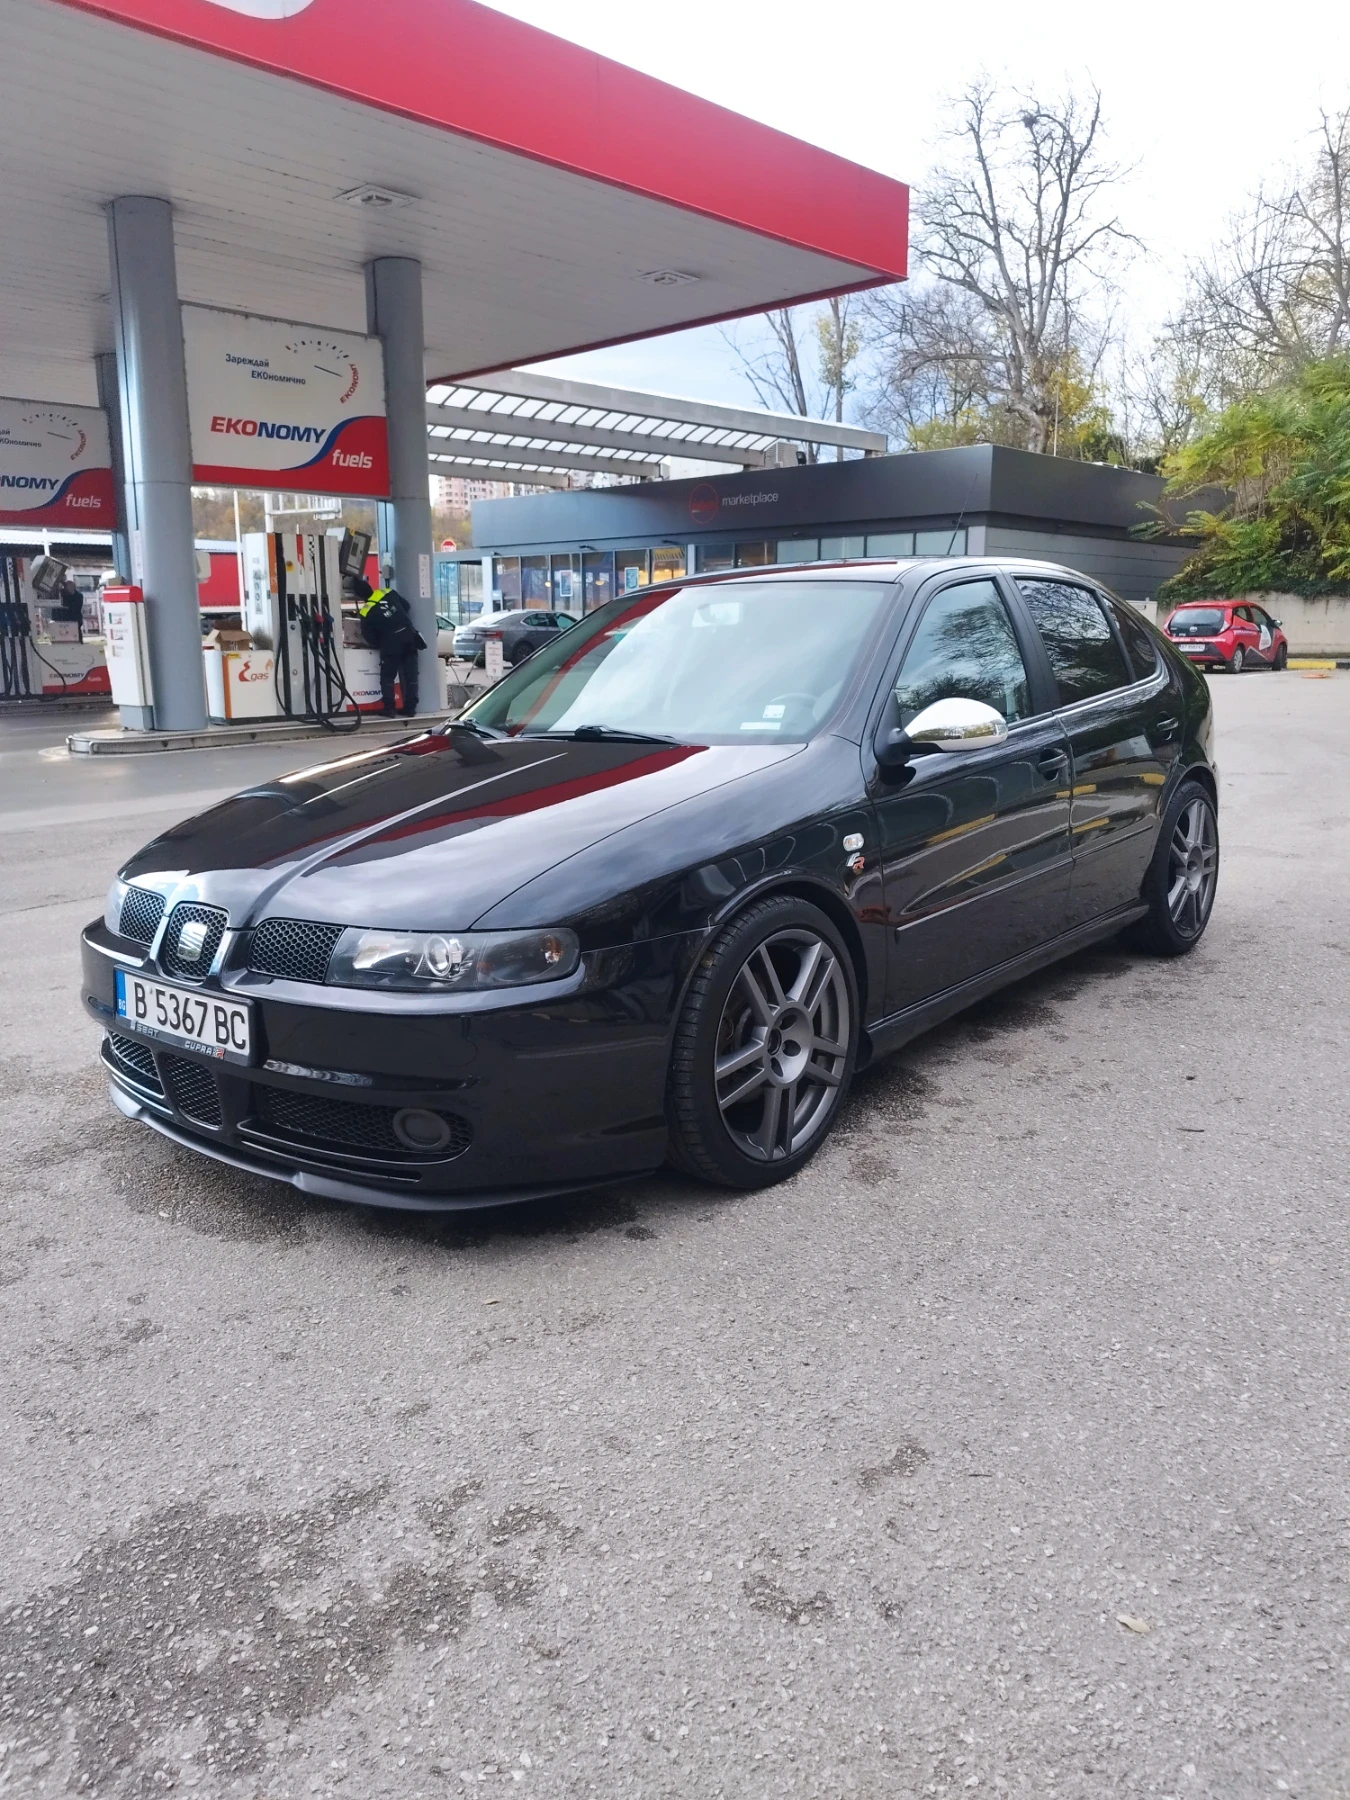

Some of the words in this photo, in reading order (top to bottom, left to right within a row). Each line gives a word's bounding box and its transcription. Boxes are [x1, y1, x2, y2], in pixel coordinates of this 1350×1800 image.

[225, 353, 270, 368] Зареждай
[251, 370, 306, 385] ЕКОномично
[340, 363, 359, 404] EKONOMY
[210, 416, 326, 443] EKONOMY
[332, 449, 373, 469] fuels
[0, 475, 59, 490] NOMY
[65, 493, 102, 508] fuels
[722, 492, 779, 506] marketplace
[118, 999, 126, 1011] BG
[134, 981, 148, 1019] B
[155, 988, 208, 1038] 5367
[214, 1005, 246, 1050] BC
[136, 1024, 159, 1037] SEAT
[184, 1040, 212, 1055] CUPRA
